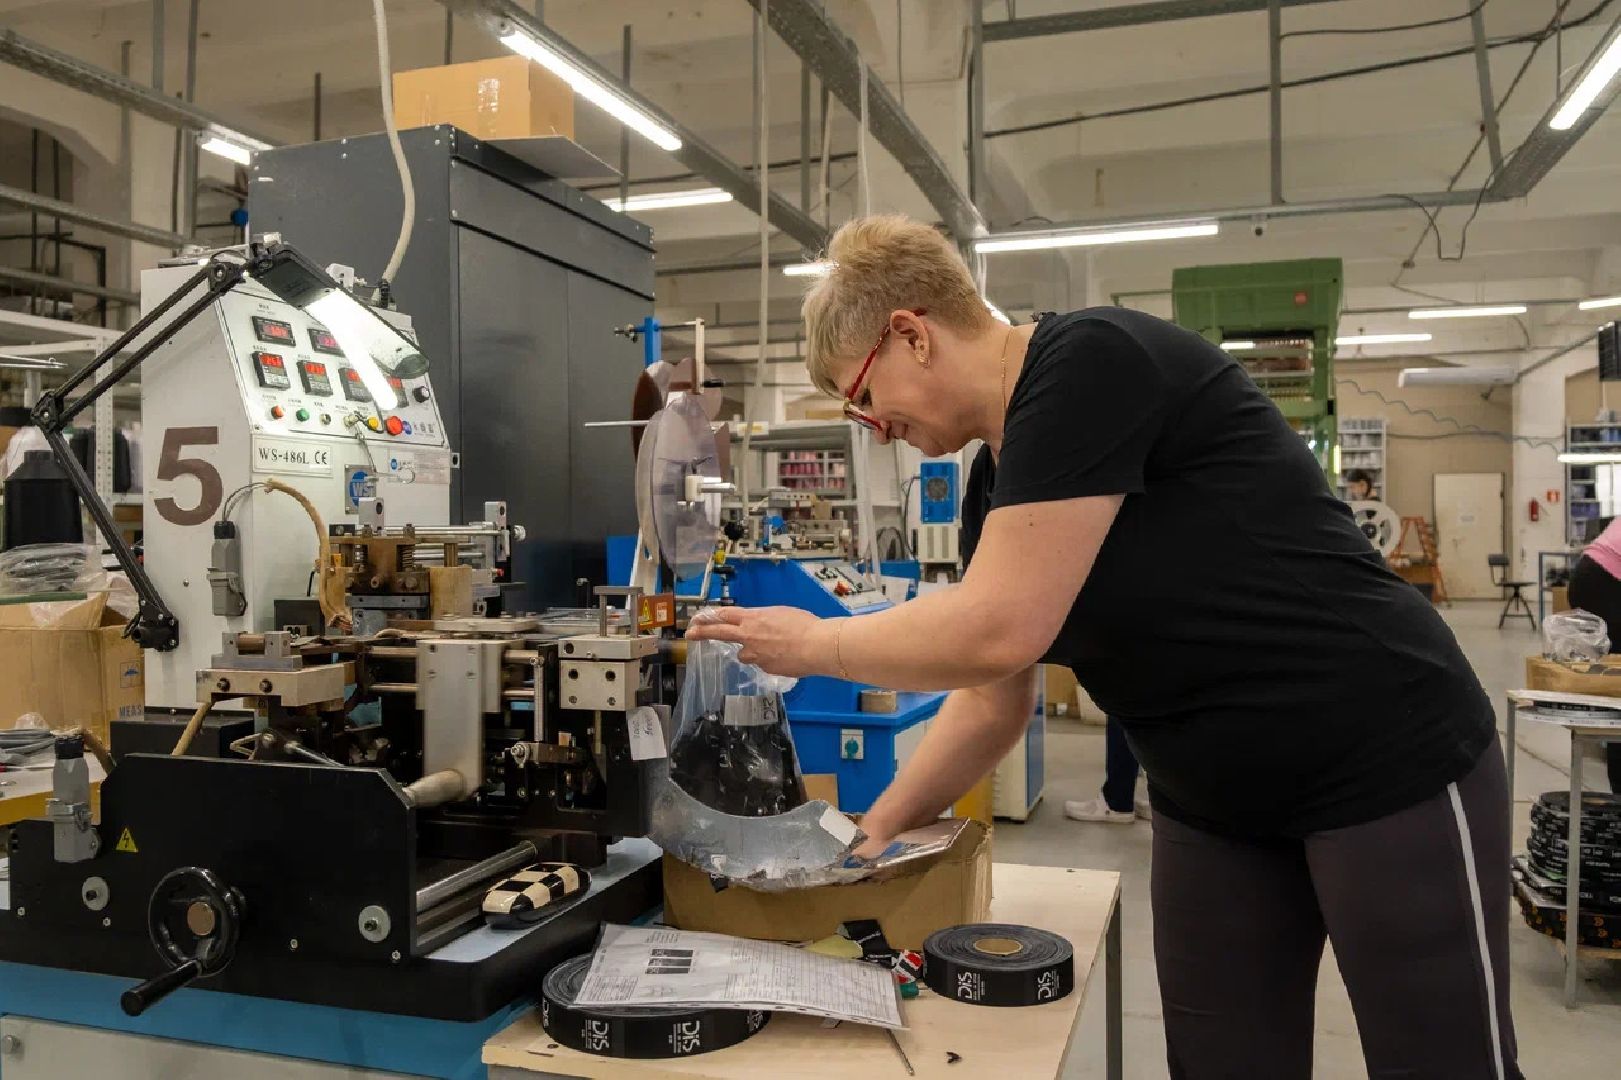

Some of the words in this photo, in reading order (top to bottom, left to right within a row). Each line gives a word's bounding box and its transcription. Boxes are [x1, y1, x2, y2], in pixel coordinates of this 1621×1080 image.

[154, 426, 224, 526] 5
[258, 447, 309, 465] WS-486L
[314, 451, 327, 465] CE
